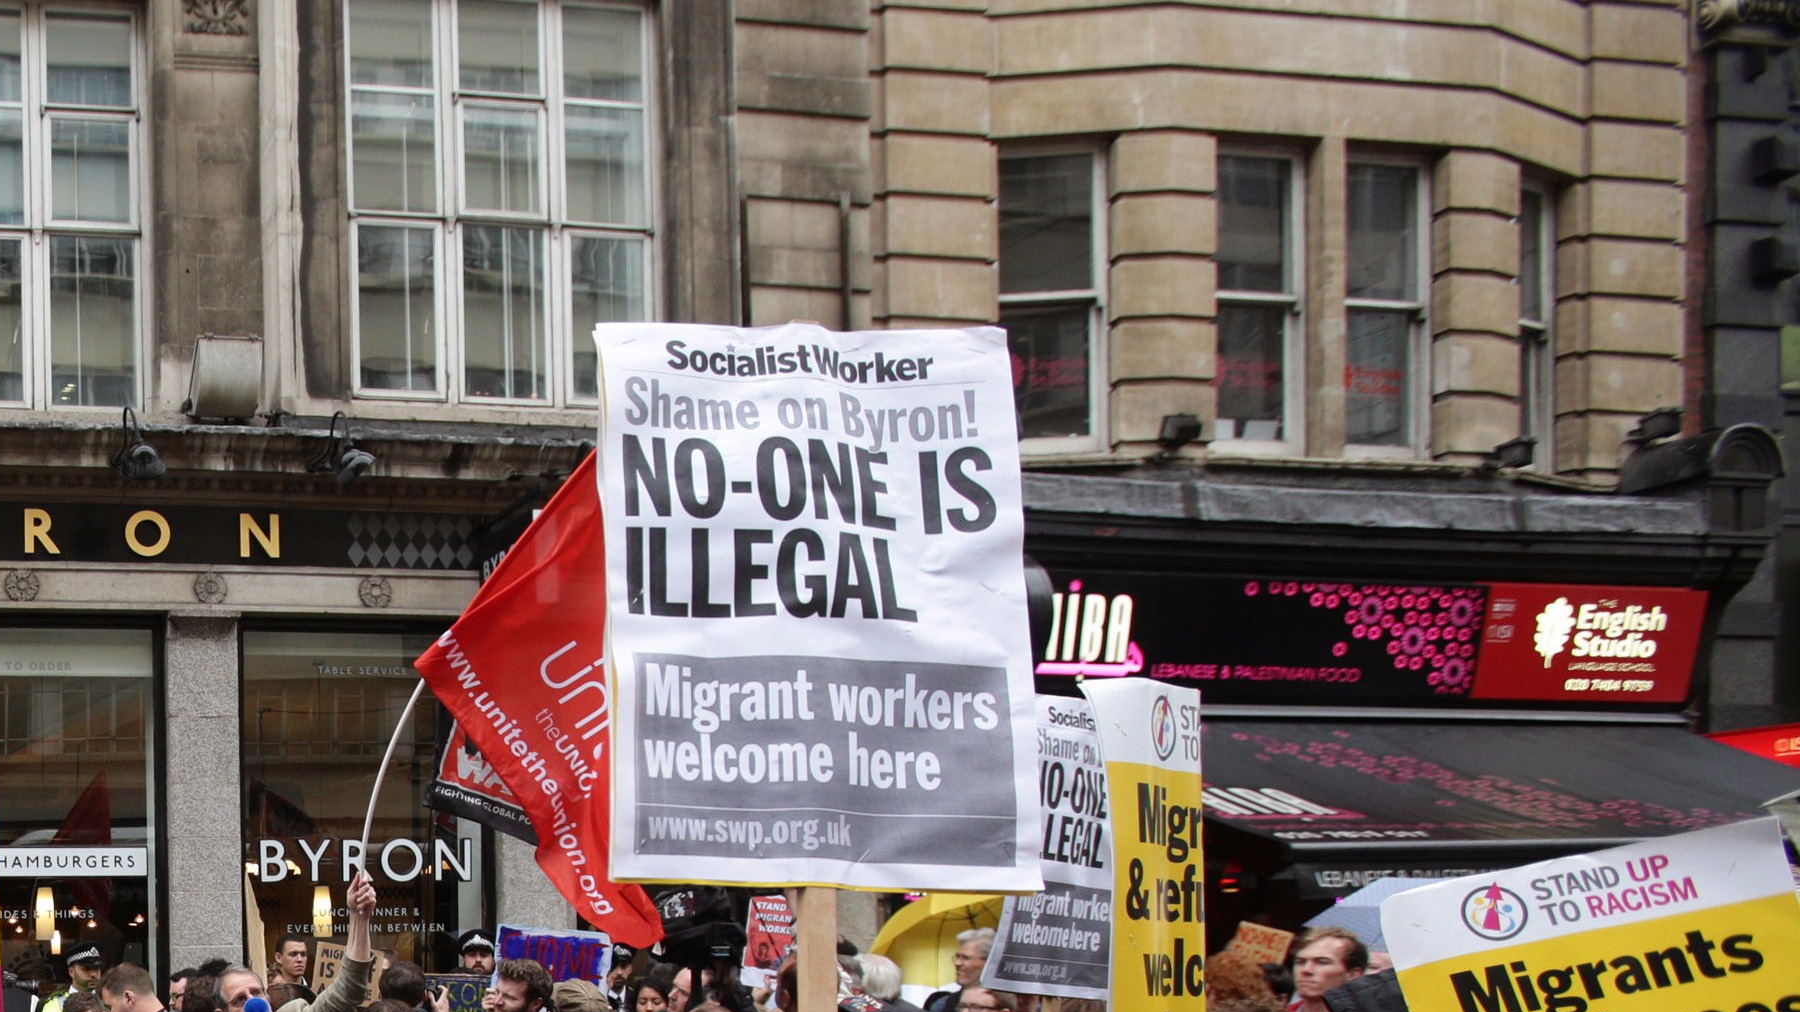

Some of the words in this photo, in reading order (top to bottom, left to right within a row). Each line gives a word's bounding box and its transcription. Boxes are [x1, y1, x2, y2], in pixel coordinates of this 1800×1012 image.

[665, 340, 812, 377] Socialist
[813, 348, 934, 386] Worker
[625, 376, 760, 431] Shame
[777, 395, 829, 431] on
[839, 389, 978, 451] Byron!
[621, 433, 897, 532] NO-ONE
[918, 446, 997, 535] IS
[625, 526, 918, 623] ILLEGAL
[1577, 603, 1668, 638] English
[1571, 630, 1657, 658] Studio
[4, 661, 23, 671] TO
[29, 661, 72, 672] ORDER
[318, 666, 353, 675] TABLE
[359, 666, 408, 676] SERVICE
[1151, 664, 1218, 679] LEBANESE
[1220, 665, 1229, 679] &
[1233, 665, 1317, 680] PALESTINIAN
[1318, 667, 1361, 682] FOOD
[1618, 662, 1656, 673] SCHOOL
[645, 662, 815, 733] Migrant
[828, 673, 999, 732] workers
[1048, 705, 1096, 733] Socialis
[645, 732, 834, 783] welcome
[849, 732, 942, 790] here
[1180, 734, 1199, 761] TO
[482, 801, 516, 820] GLOBAL
[1137, 782, 1201, 862] Migr
[648, 813, 852, 850] www.swp.org.uk
[1040, 813, 1104, 869] LEGAL
[259, 838, 472, 883] BYRON
[1530, 866, 1620, 901] STAND
[1625, 854, 1670, 883] UP
[756, 902, 786, 911] STAND
[1126, 858, 1149, 922] &
[1156, 863, 1204, 923] refu
[1539, 900, 1581, 927] TO
[1590, 877, 1699, 918] RACISM
[46, 909, 94, 919] THINGS
[287, 924, 350, 934] EVERYTHI
[387, 923, 445, 932] BETWEEN
[371, 908, 407, 916] INNER
[413, 908, 420, 916] &
[756, 913, 792, 922] MIGRAN
[758, 924, 791, 934] WORK
[1143, 938, 1205, 998] welc
